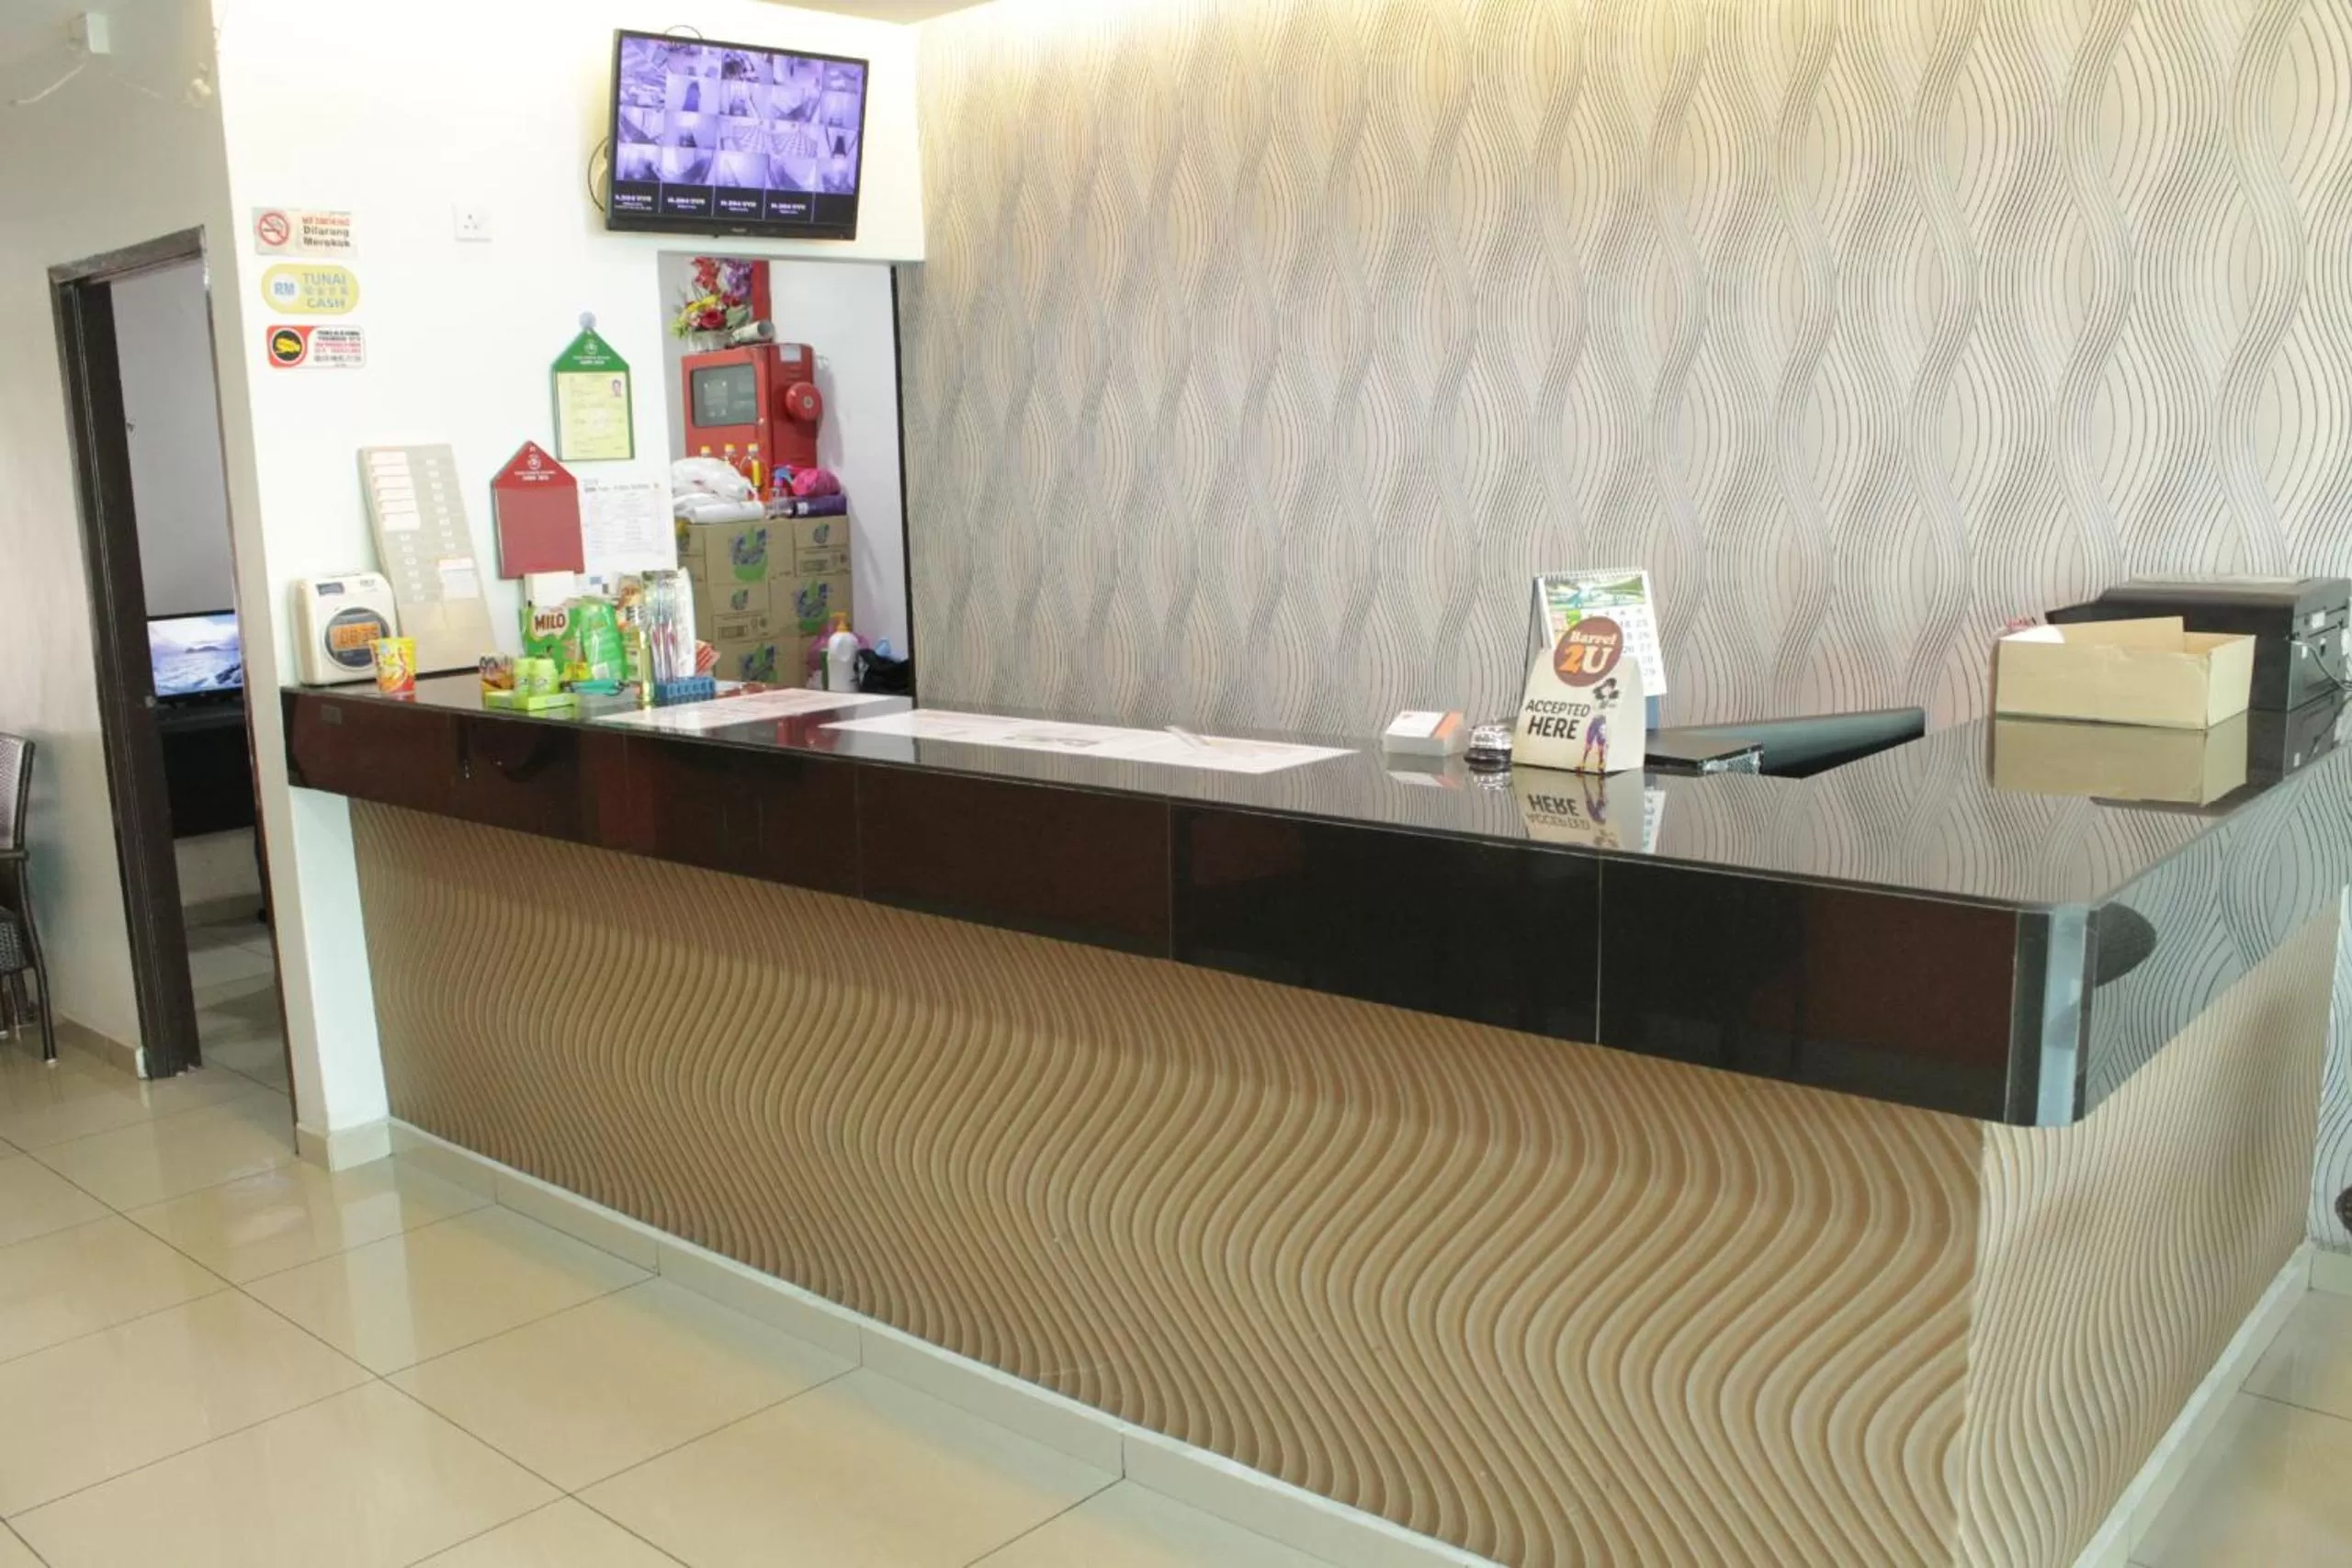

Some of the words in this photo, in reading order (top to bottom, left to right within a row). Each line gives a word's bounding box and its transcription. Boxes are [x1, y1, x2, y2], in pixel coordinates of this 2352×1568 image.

[302, 273, 346, 285] TUNAI
[274, 282, 295, 295] RM
[307, 298, 345, 309] CASH
[535, 613, 566, 632] MILO
[1569, 629, 1619, 646] Barrel
[1559, 643, 1613, 674] 2U
[1525, 699, 1590, 717] ACCEPTED
[1527, 715, 1580, 739] HERE
